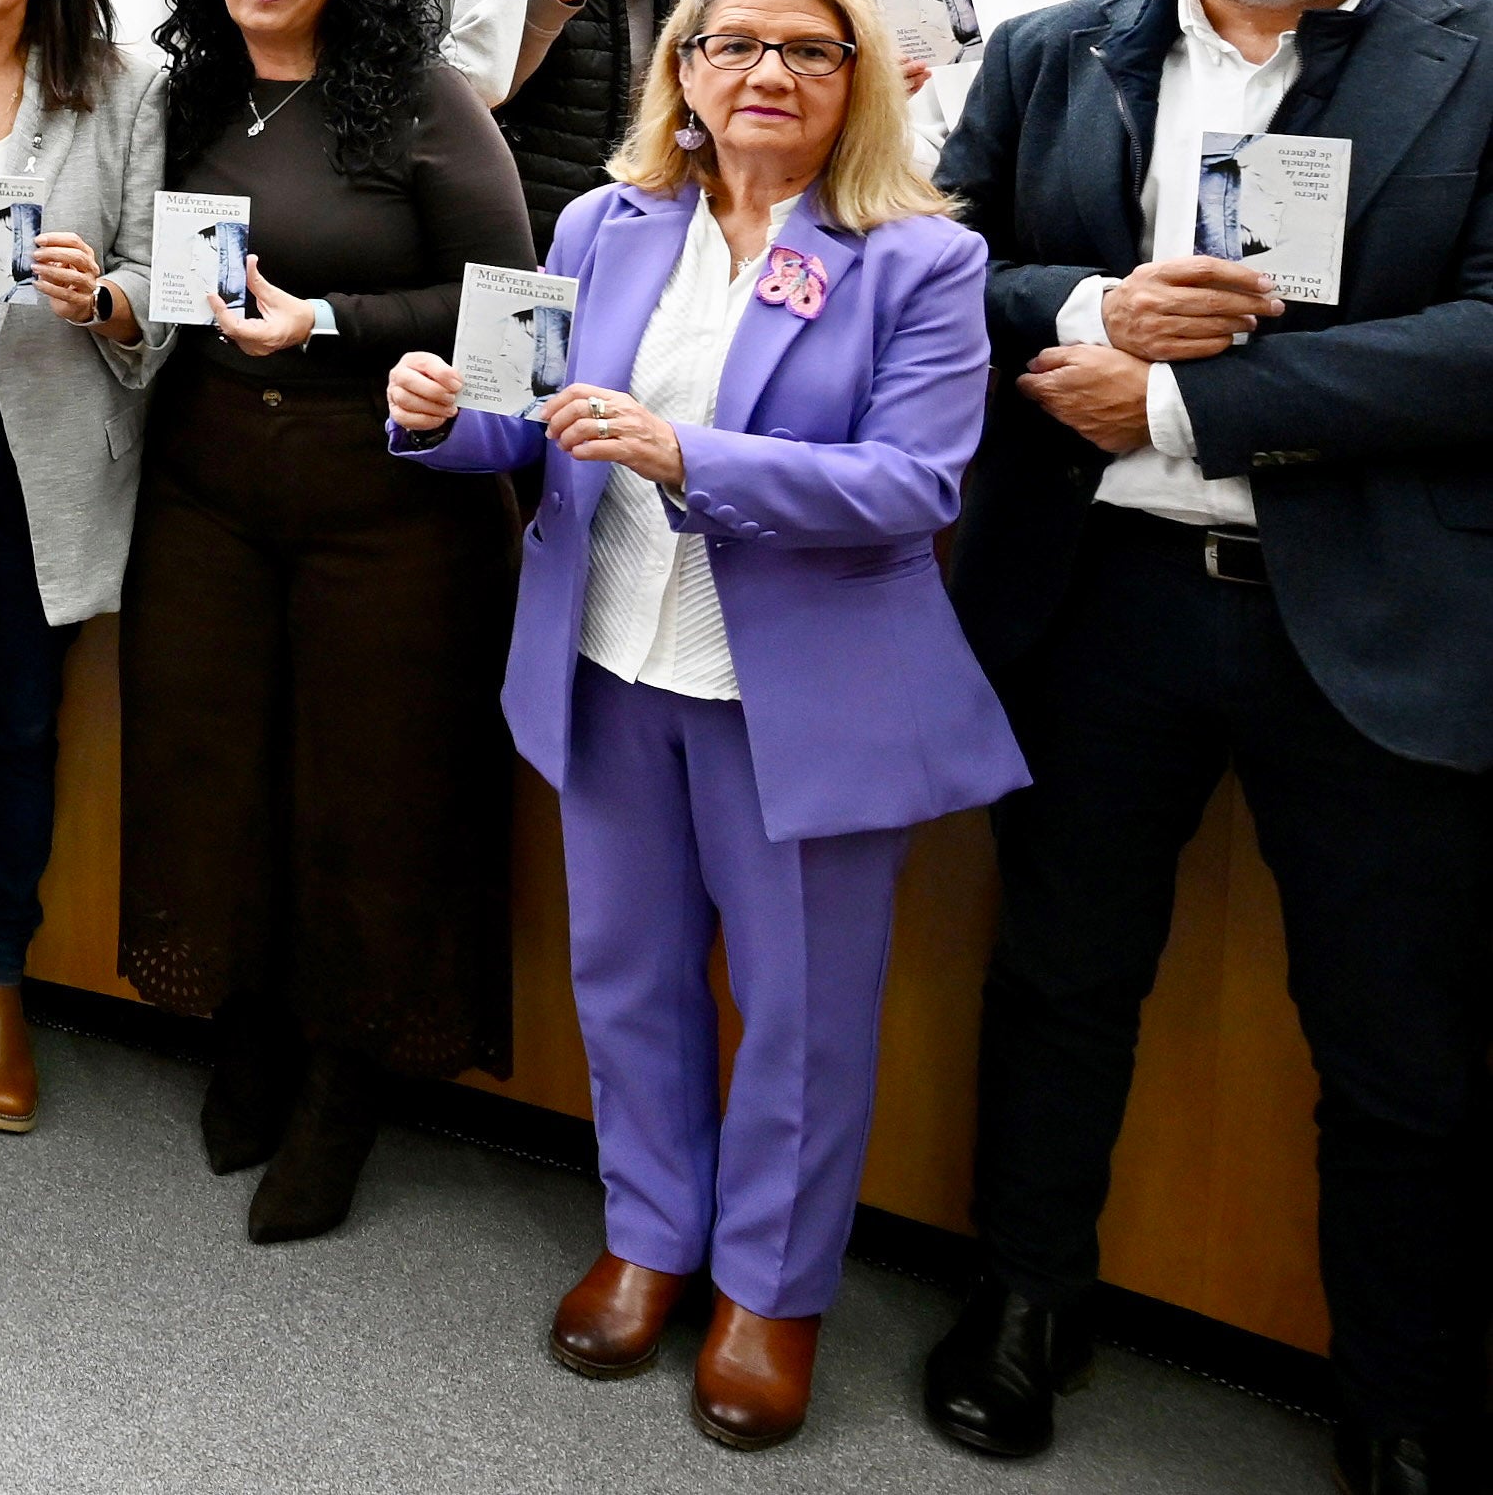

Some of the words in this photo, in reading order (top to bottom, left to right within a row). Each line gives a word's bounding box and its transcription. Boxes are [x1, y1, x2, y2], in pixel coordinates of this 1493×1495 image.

[1295, 191, 1328, 201] Micro
[193, 208, 240, 216] IGUALDAD
[1300, 277, 1321, 285] POR
[509, 287, 564, 301] IGUALDAD
[1274, 285, 1320, 299] MUÉV
[468, 355, 492, 364] Micro
